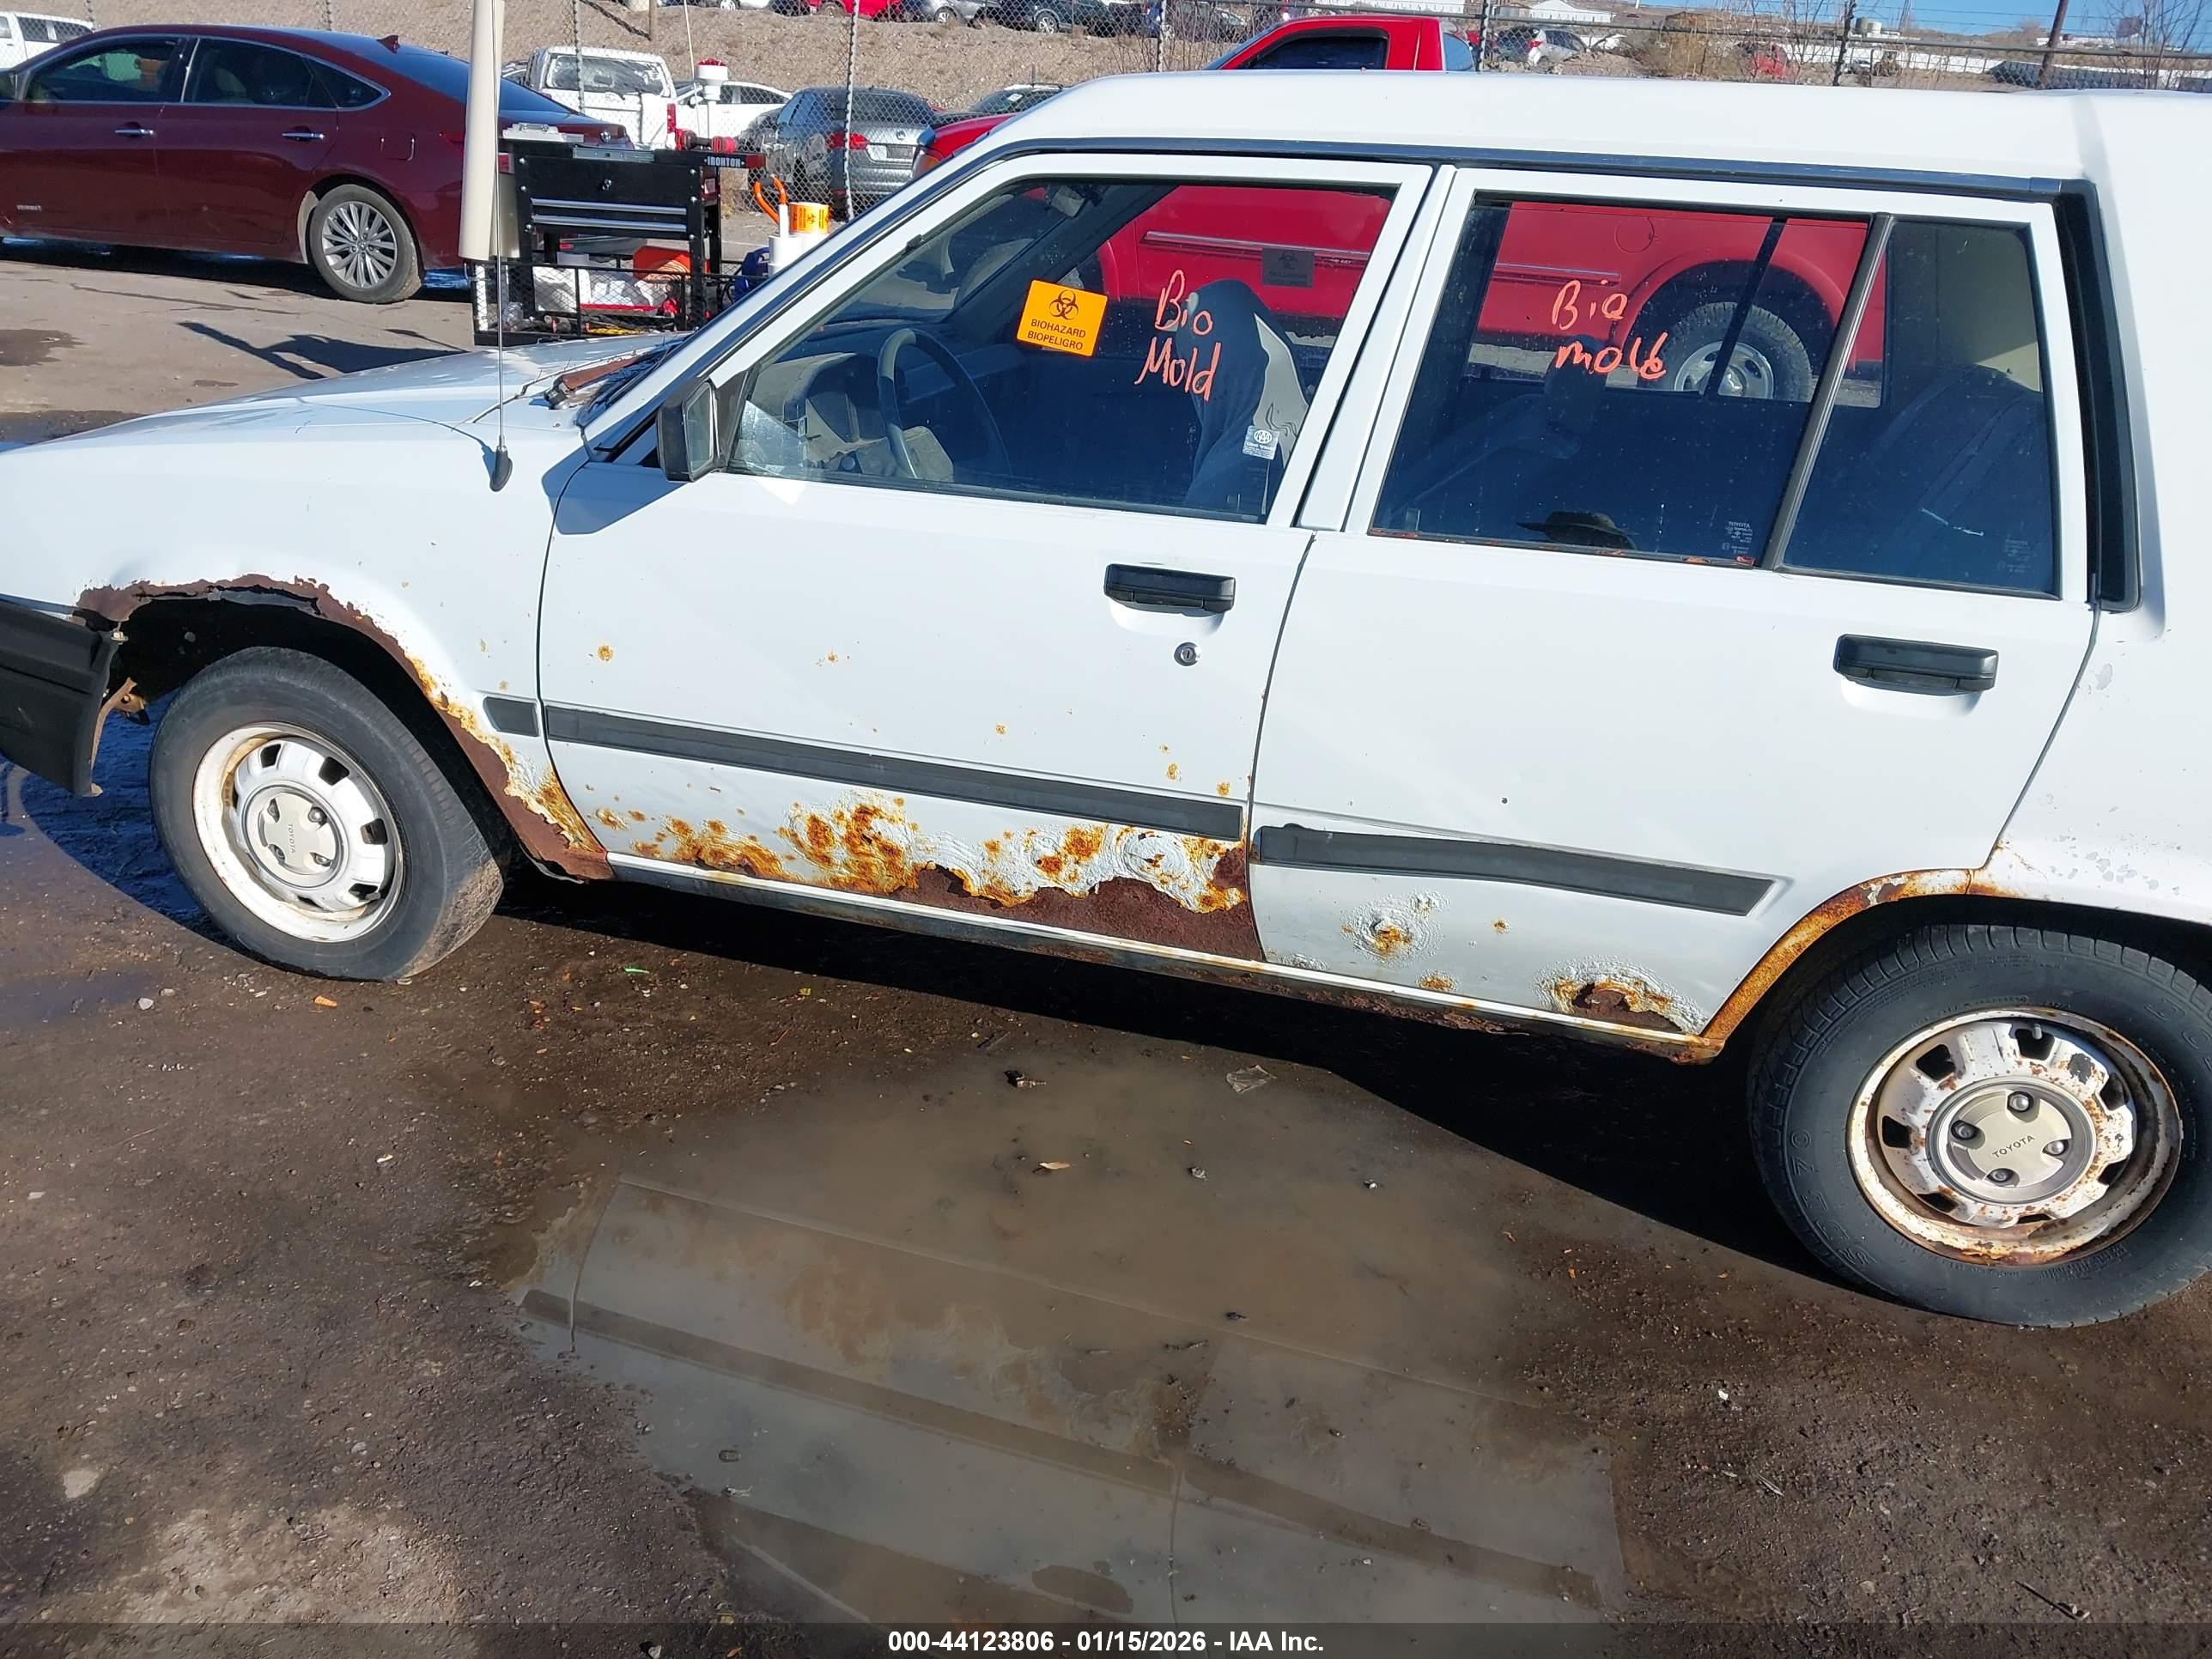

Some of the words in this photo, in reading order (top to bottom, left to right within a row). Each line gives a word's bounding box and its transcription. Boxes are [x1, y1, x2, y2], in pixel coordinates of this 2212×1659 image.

[707, 155, 741, 167] IRONTON
[1155, 270, 1213, 336] Bio
[1552, 280, 1628, 331] Bio
[1027, 331, 1083, 350] BIOPELIGRO
[1030, 319, 1086, 338] BIOHAZARD
[1134, 336, 1222, 402] Mold
[287, 823, 296, 854] TOYOTA
[1992, 1134, 2036, 1158] TOYOTA
